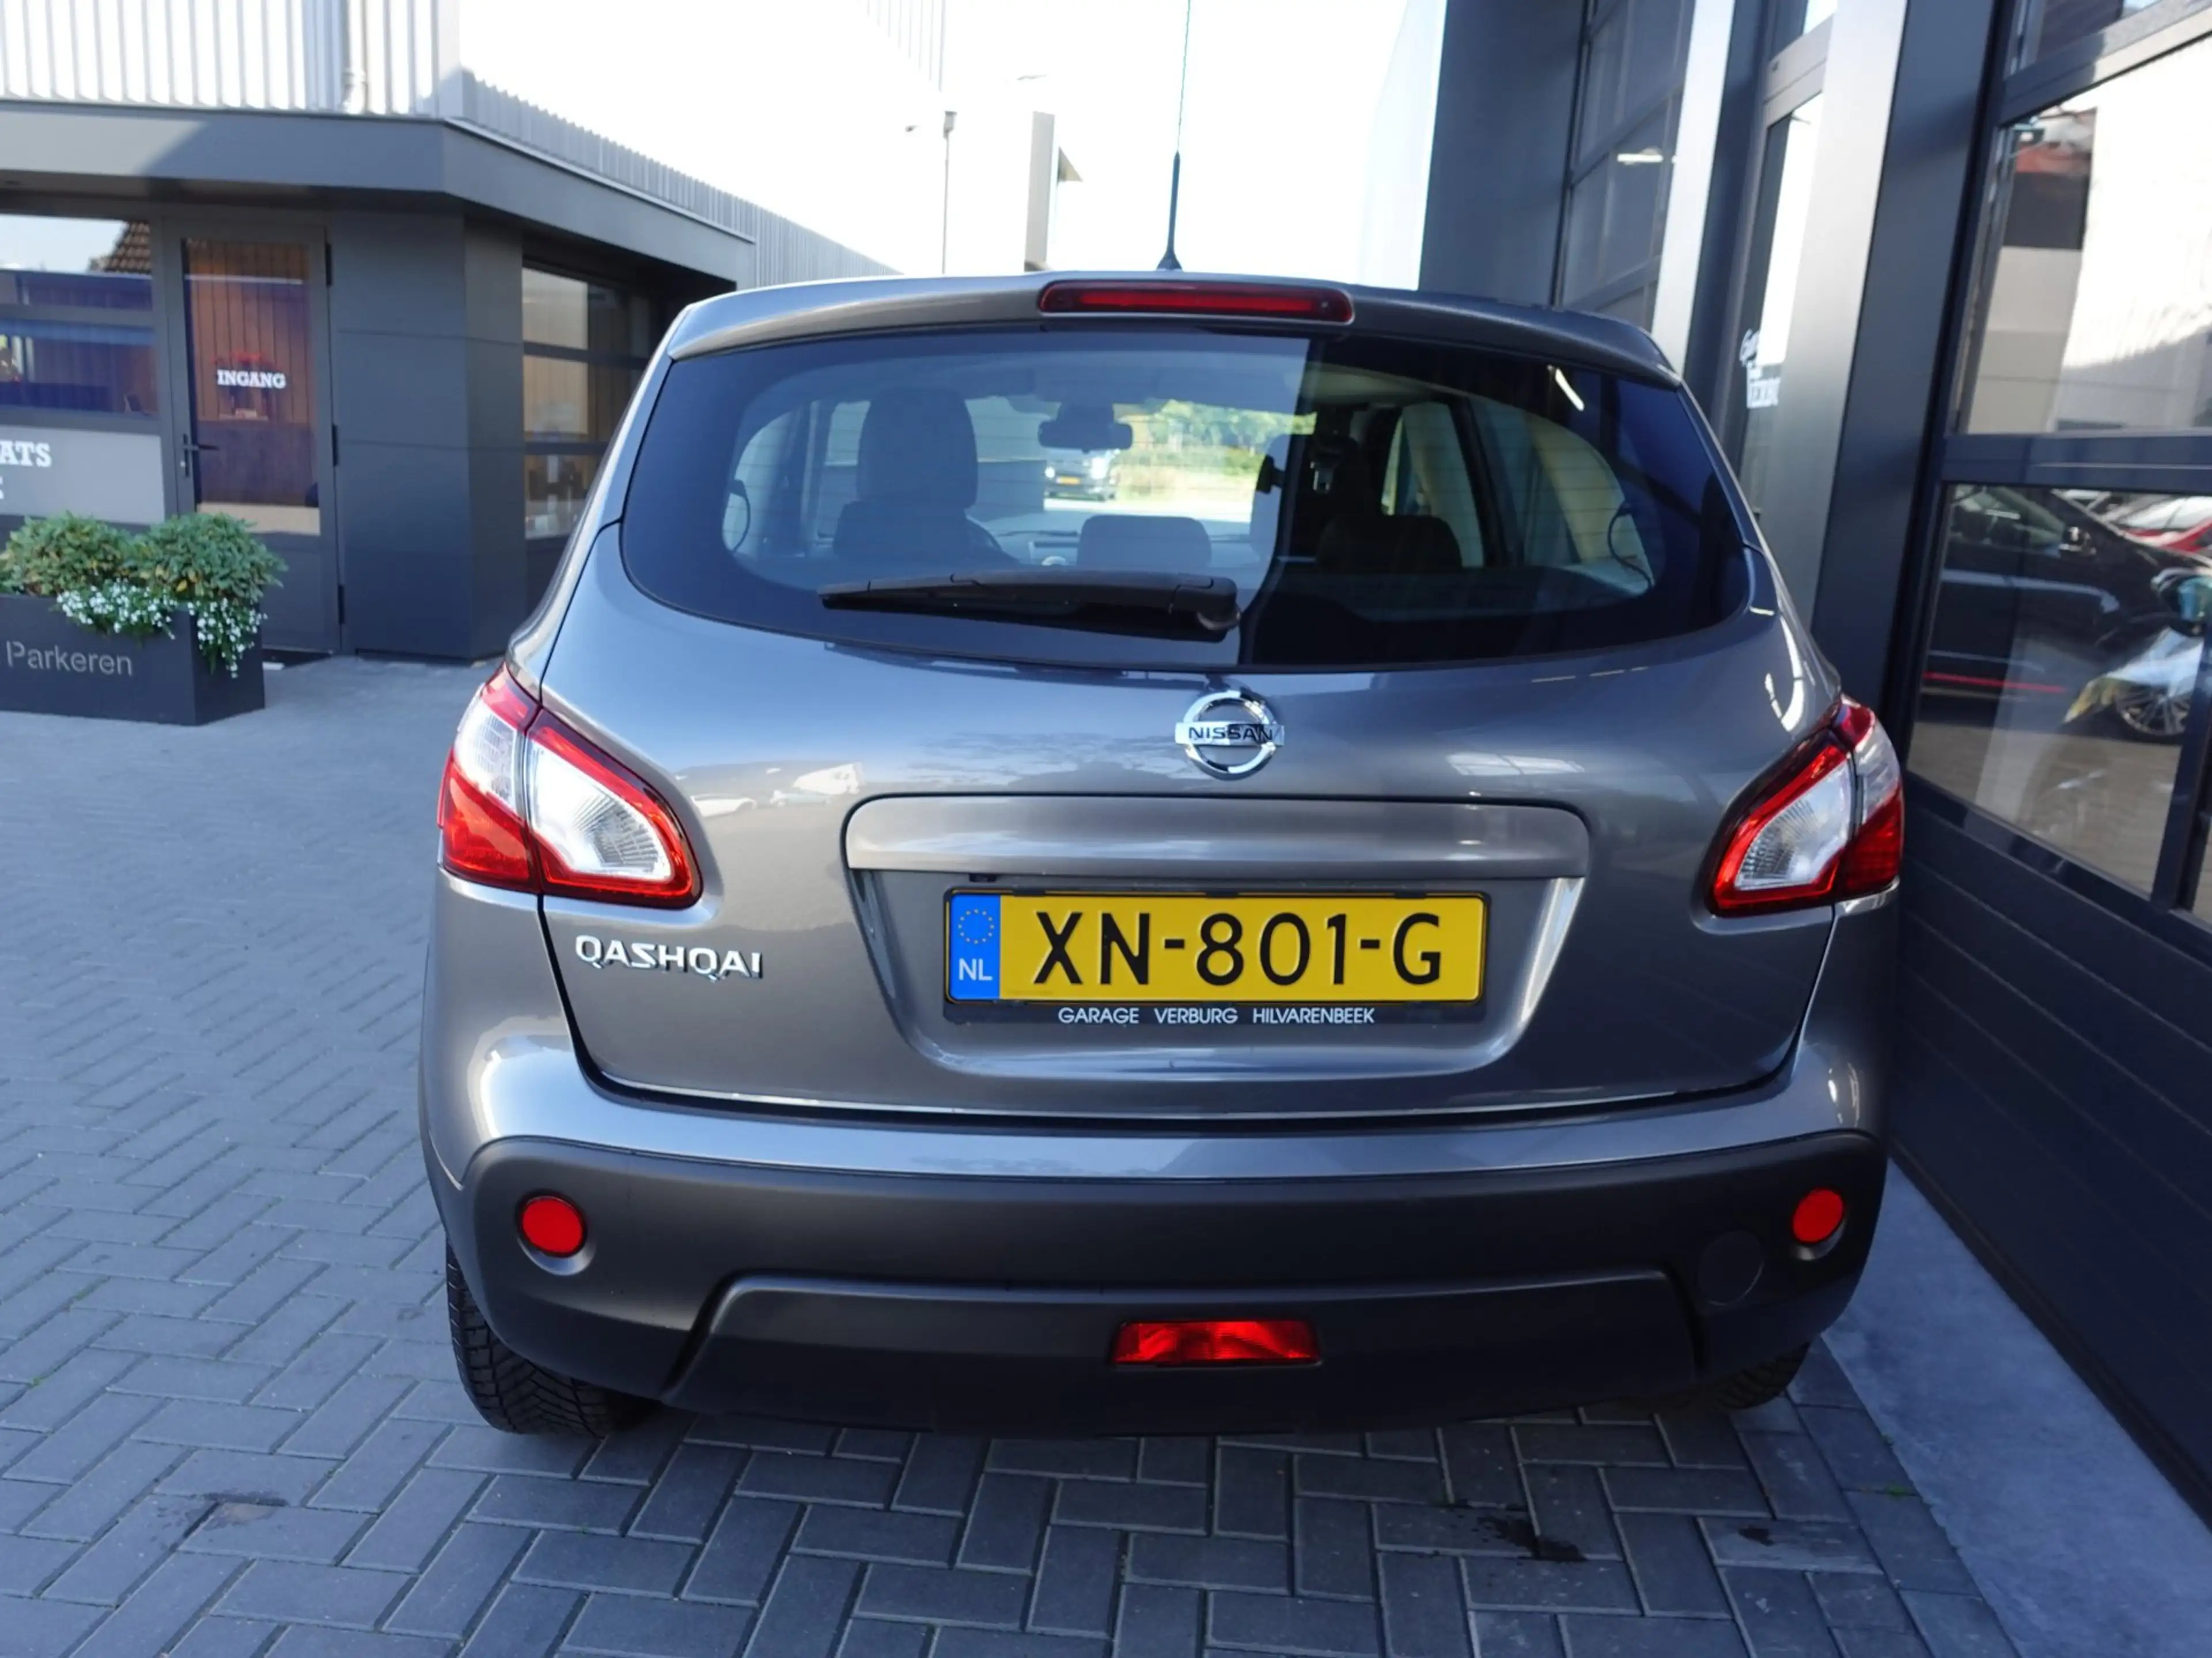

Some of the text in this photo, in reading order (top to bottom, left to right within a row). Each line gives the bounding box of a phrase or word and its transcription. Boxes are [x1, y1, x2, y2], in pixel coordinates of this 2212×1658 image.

[217, 369, 286, 389] INGANG
[6, 641, 132, 676] Parkeren
[1188, 726, 1273, 741] NISSAN
[576, 934, 763, 982] QASHQAI
[1033, 911, 1441, 986] XN-801-G
[959, 959, 993, 981] NL
[1058, 1007, 1376, 1025] GARAGE VERBURG HILVARENBEEK
